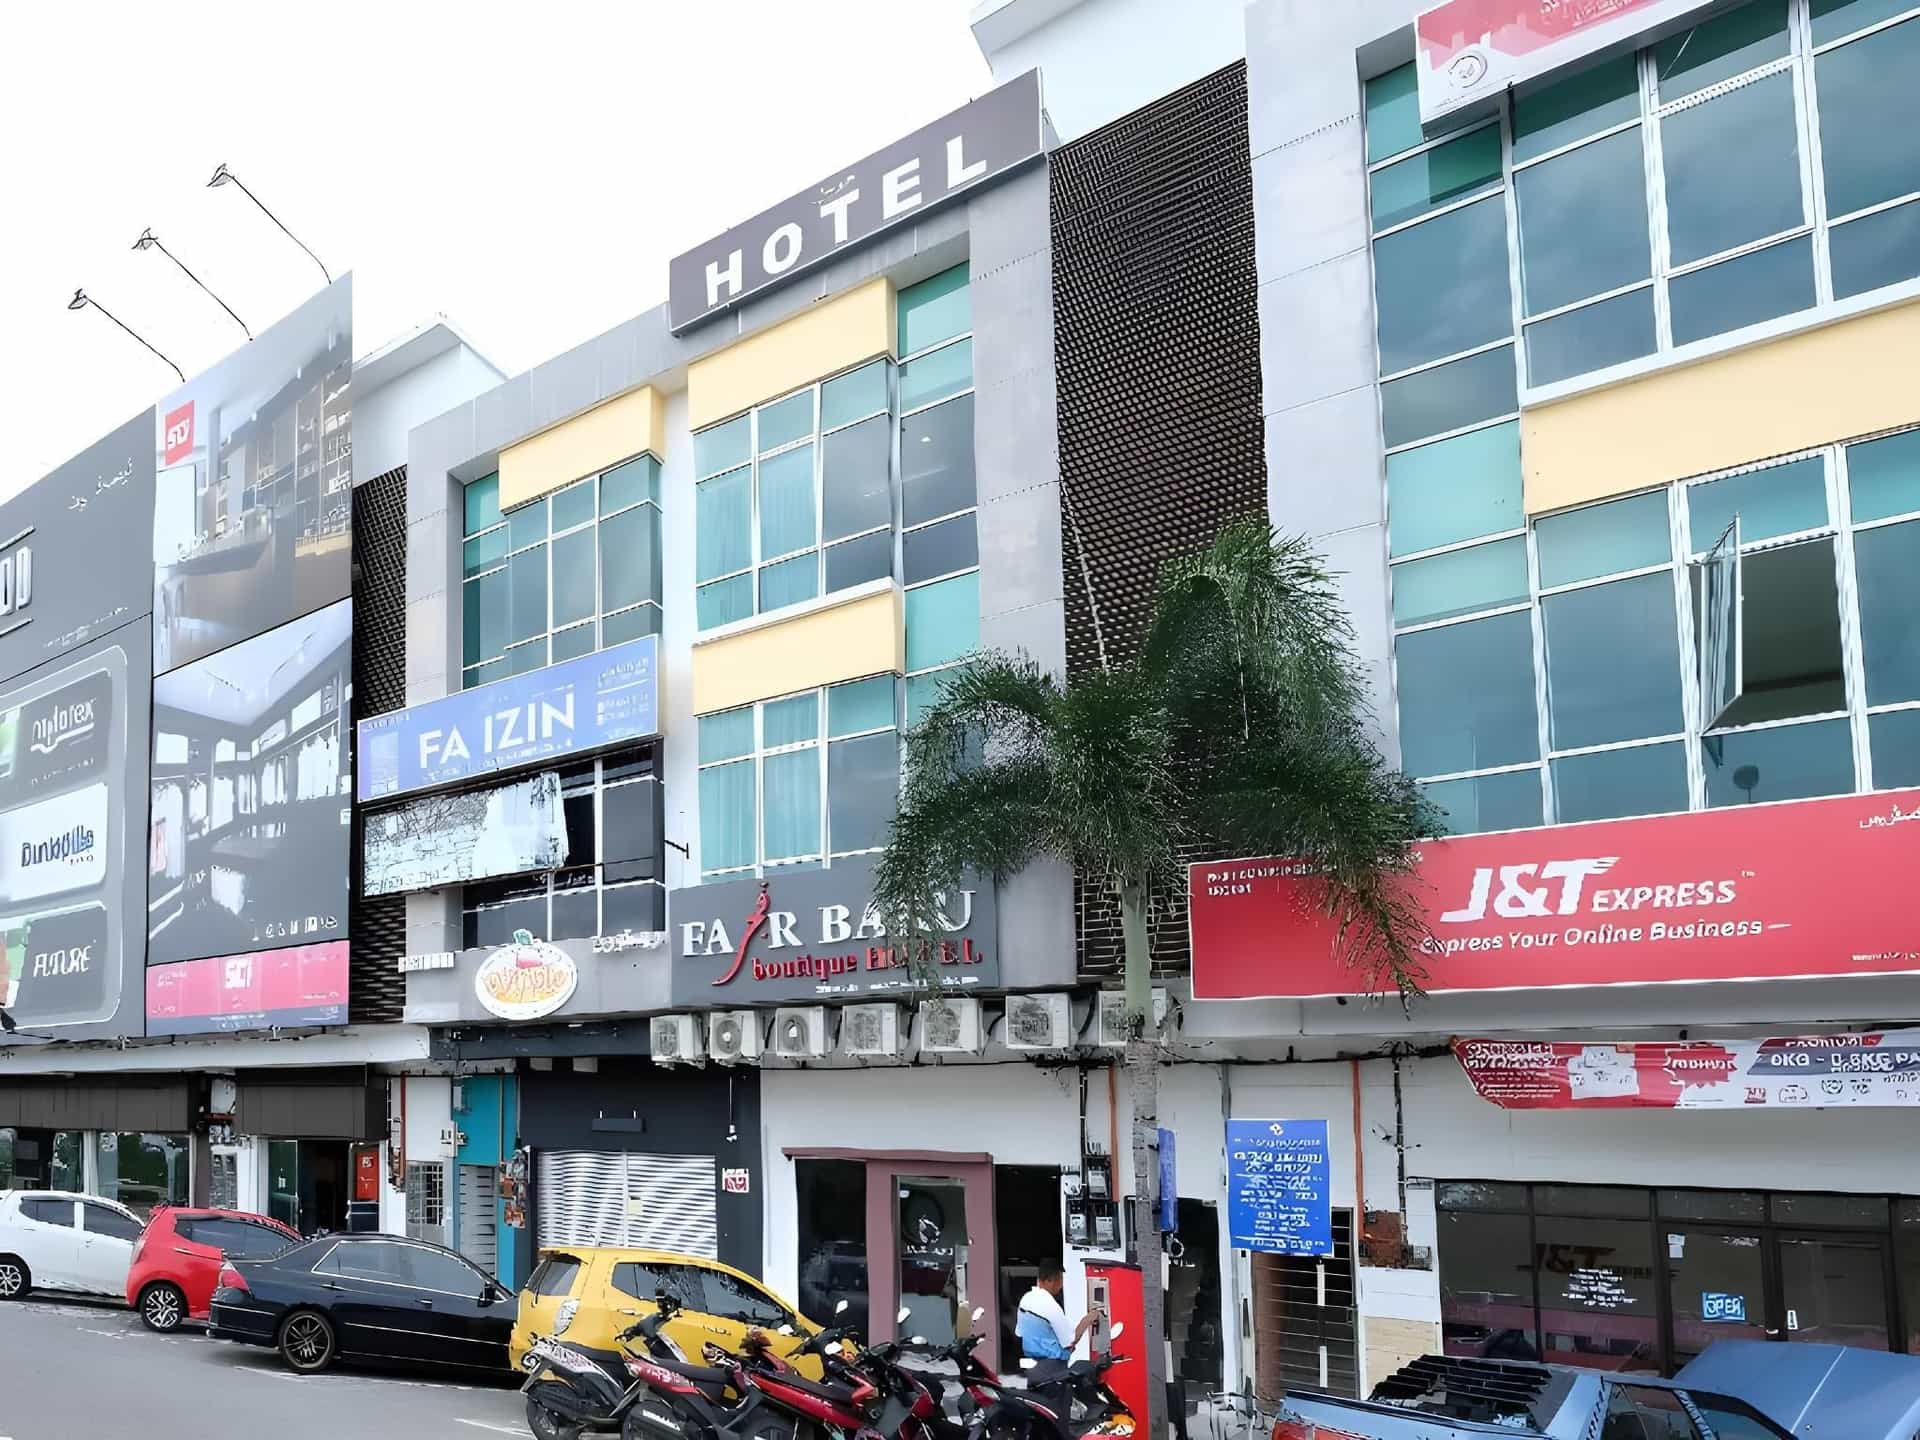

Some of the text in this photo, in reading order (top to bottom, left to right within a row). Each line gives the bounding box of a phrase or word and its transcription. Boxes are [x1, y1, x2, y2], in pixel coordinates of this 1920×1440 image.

[705, 134, 987, 307] HOTEL
[1440, 856, 1621, 922] J&T
[1591, 880, 1736, 912] EXPRESS
[1509, 930, 1558, 949] Your
[1564, 923, 1642, 947] Online
[1649, 919, 1763, 941] Business
